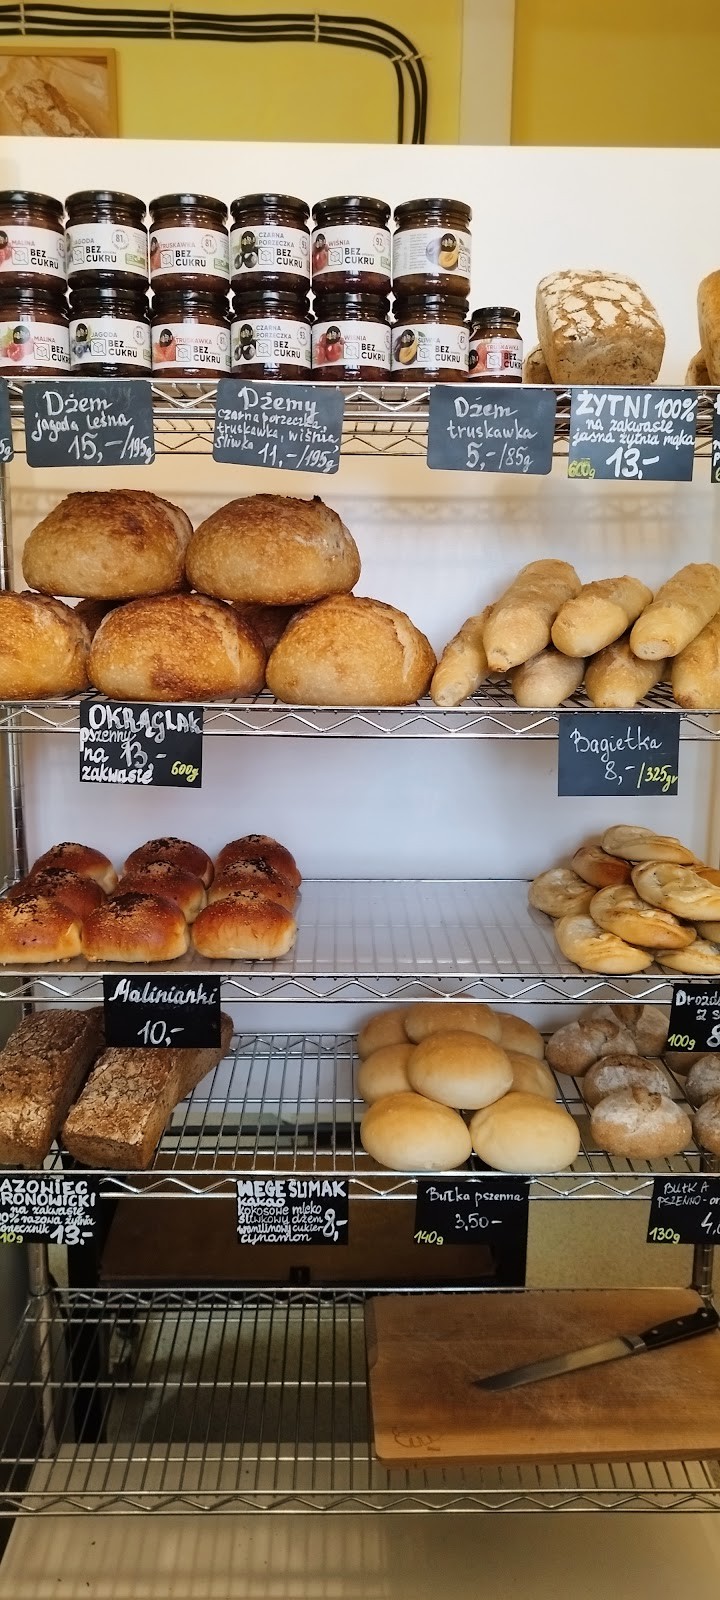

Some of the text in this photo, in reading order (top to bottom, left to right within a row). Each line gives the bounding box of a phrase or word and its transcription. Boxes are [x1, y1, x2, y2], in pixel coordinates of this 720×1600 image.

[85, 245, 102, 254] BEZ
[258, 239, 295, 248] PORZECZKA
[30, 248, 47, 258] BEZ
[175, 250, 191, 258] BEZ
[276, 248, 292, 257] BEZ
[344, 247, 361, 256] BEZ
[30, 257, 59, 270] CUKRU
[85, 254, 117, 263] CUKRU
[175, 258, 207, 267] CUKRU
[276, 257, 303, 269] CUKRU
[344, 256, 375, 266] CUKRU
[51, 345, 64, 354] BEZ
[108, 340, 125, 349] BEZ
[193, 346, 209, 354] BEZ
[273, 341, 289, 349] BEZ
[361, 343, 376, 352] BEZ
[435, 345, 450, 354] BEZ
[108, 348, 138, 358] CUKRU
[193, 354, 221, 364] CUKRU
[273, 349, 301, 359] CUKRU
[361, 351, 386, 362] CUKRU
[435, 353, 461, 363] CUKRU
[504, 352, 517, 360] BEZ
[42, 390, 113, 416] Dżem
[237, 386, 319, 423] Dżemy
[453, 396, 518, 419] Dżem
[575, 389, 652, 419] ŻYTNI
[654, 397, 698, 422] 100%
[218, 408, 260, 423] czarna
[31, 410, 133, 442] jagoda leśna
[446, 418, 538, 439] truskawka
[585, 418, 674, 433] na zakwasie
[571, 428, 616, 447] jasna
[619, 431, 661, 450] żytnia
[663, 429, 696, 450] mąka
[605, 446, 660, 480] 13,-
[569, 725, 663, 763] Bagietka
[84, 747, 110, 763] na
[171, 761, 200, 782] 600g
[108, 978, 218, 1005] Malinianki
[675, 989, 720, 1006] Drożd
[137, 1020, 185, 1047] 10,-
[667, 1033, 696, 1051] 100g
[0, 1178, 88, 1195] AZOWIEC
[236, 1180, 287, 1198] WEGE
[0, 1191, 96, 1208] RONOWICKI
[237, 1197, 286, 1208] kakao
[474, 1191, 524, 1208] pszenna
[10, 1205, 85, 1217] na zakwasie
[238, 1201, 322, 1217] kokosowe mleko
[0, 1212, 20, 1224] 0%
[21, 1215, 63, 1225] razowa
[292, 1214, 323, 1224] dżem
[292, 1223, 325, 1233] cukier
[240, 1232, 312, 1246] cynamon
[413, 1230, 444, 1246] 140g
[648, 1226, 681, 1245] 130g
